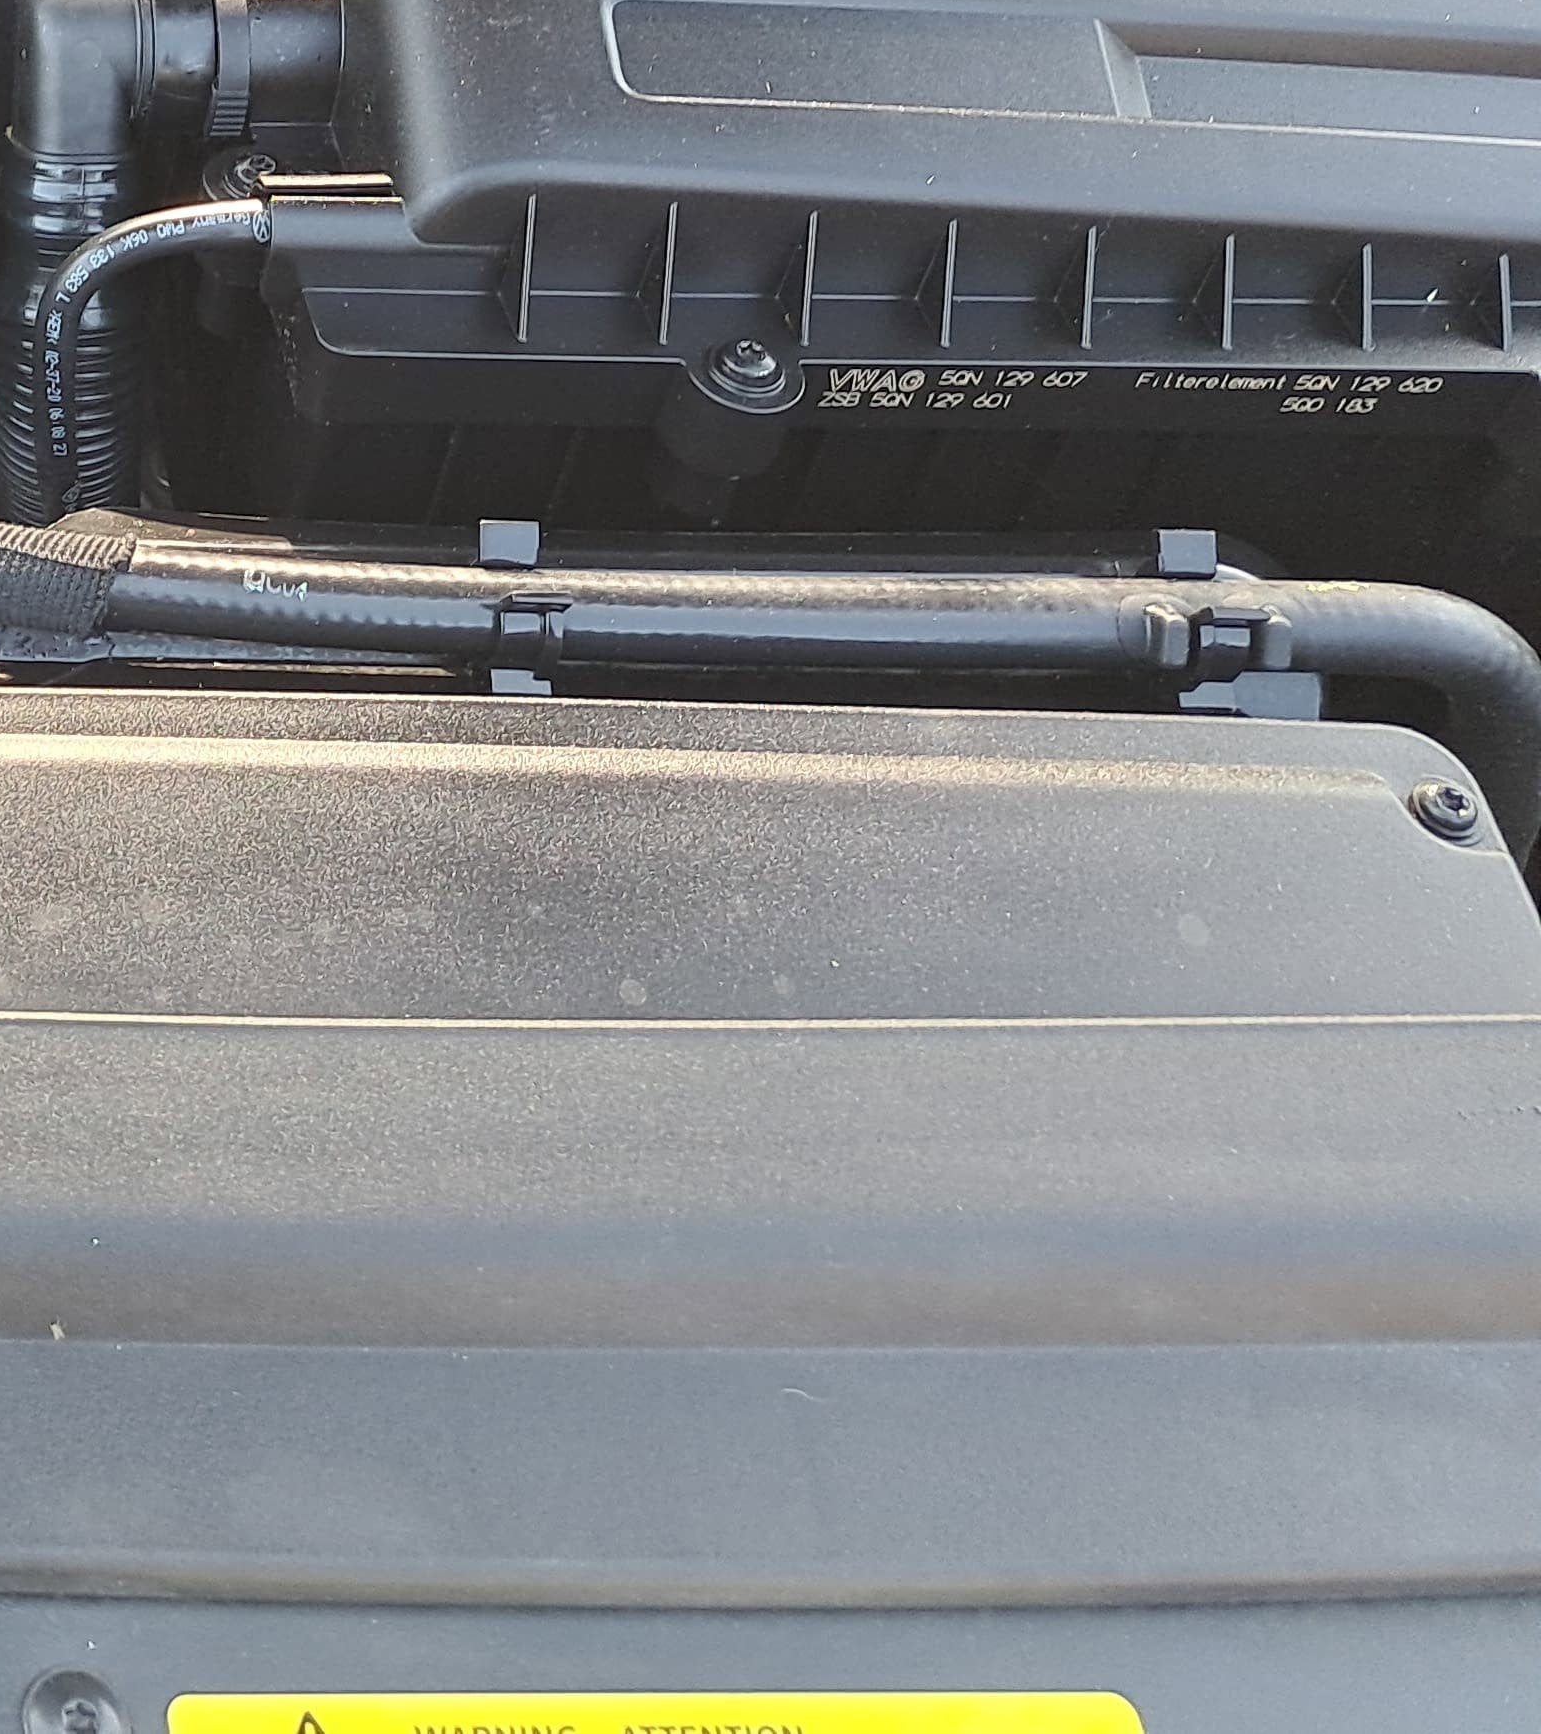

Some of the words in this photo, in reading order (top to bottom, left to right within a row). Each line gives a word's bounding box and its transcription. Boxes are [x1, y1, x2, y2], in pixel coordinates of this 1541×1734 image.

[121, 229, 149, 252] 06K
[89, 245, 116, 269] 133
[65, 266, 90, 292] 583
[830, 369, 925, 392] VWAG
[995, 371, 1035, 387] 129
[1043, 371, 1089, 387] 607
[1134, 371, 1287, 391] Filterelement
[1349, 376, 1392, 392] 129
[1398, 377, 1444, 394] 620
[817, 391, 859, 408] ZSB
[925, 393, 965, 408] 129
[973, 393, 1013, 409] 601
[1335, 398, 1379, 413] 183
